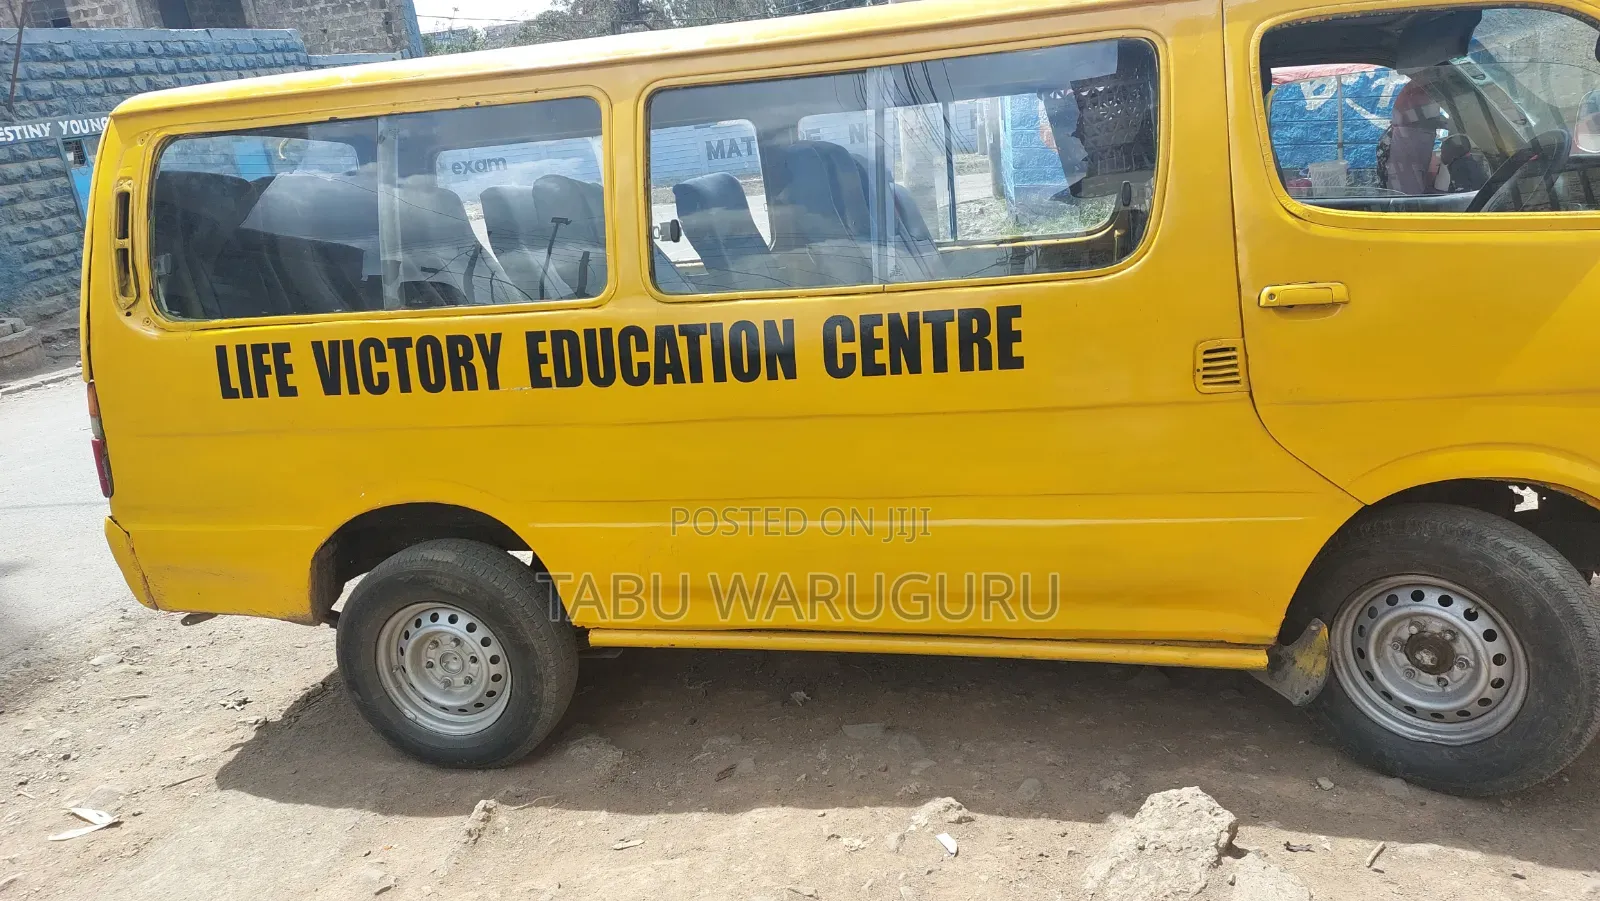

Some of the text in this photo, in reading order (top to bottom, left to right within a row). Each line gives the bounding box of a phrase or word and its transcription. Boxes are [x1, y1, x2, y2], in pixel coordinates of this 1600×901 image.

[451, 156, 507, 175] exam
[215, 304, 1025, 399] LIFE VICTORY EDUCATION CENTRE
